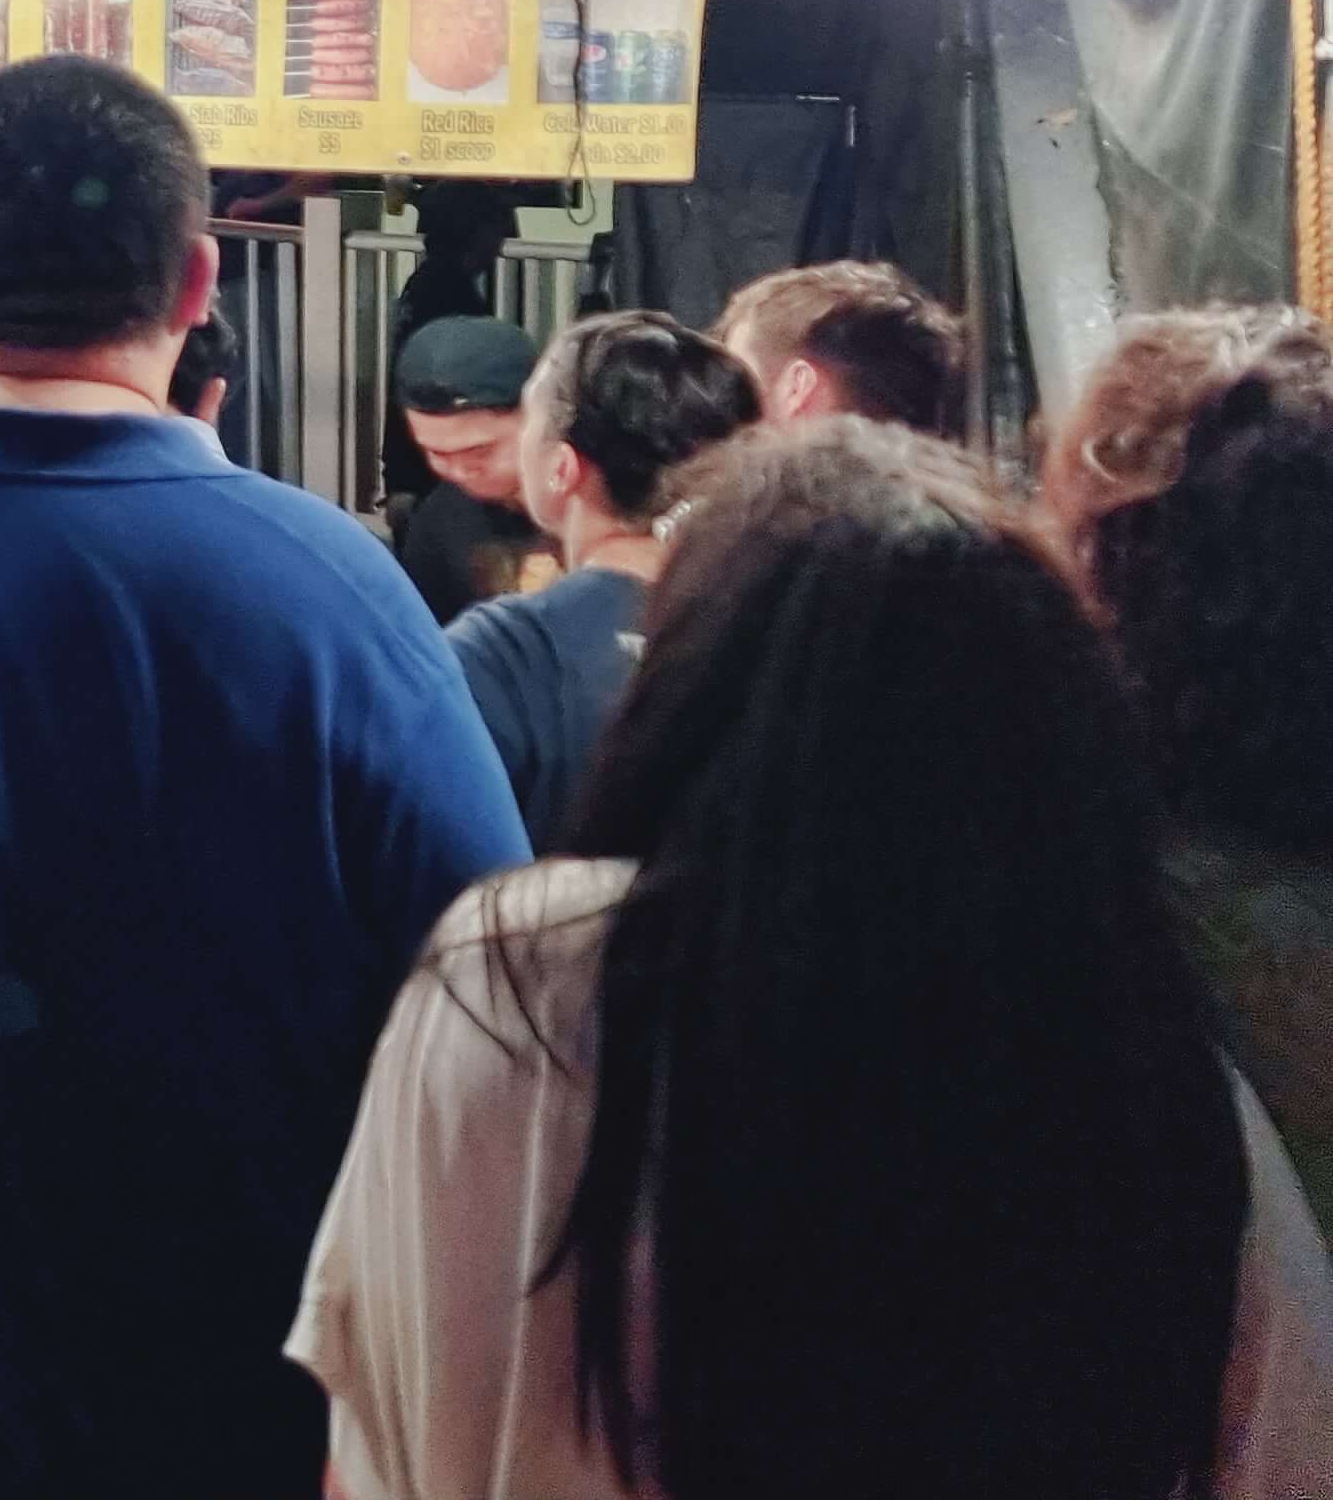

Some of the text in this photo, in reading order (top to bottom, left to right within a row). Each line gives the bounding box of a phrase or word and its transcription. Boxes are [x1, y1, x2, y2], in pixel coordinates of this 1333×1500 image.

[298, 105, 365, 130] Sausage
[420, 109, 496, 135] Red Rice
